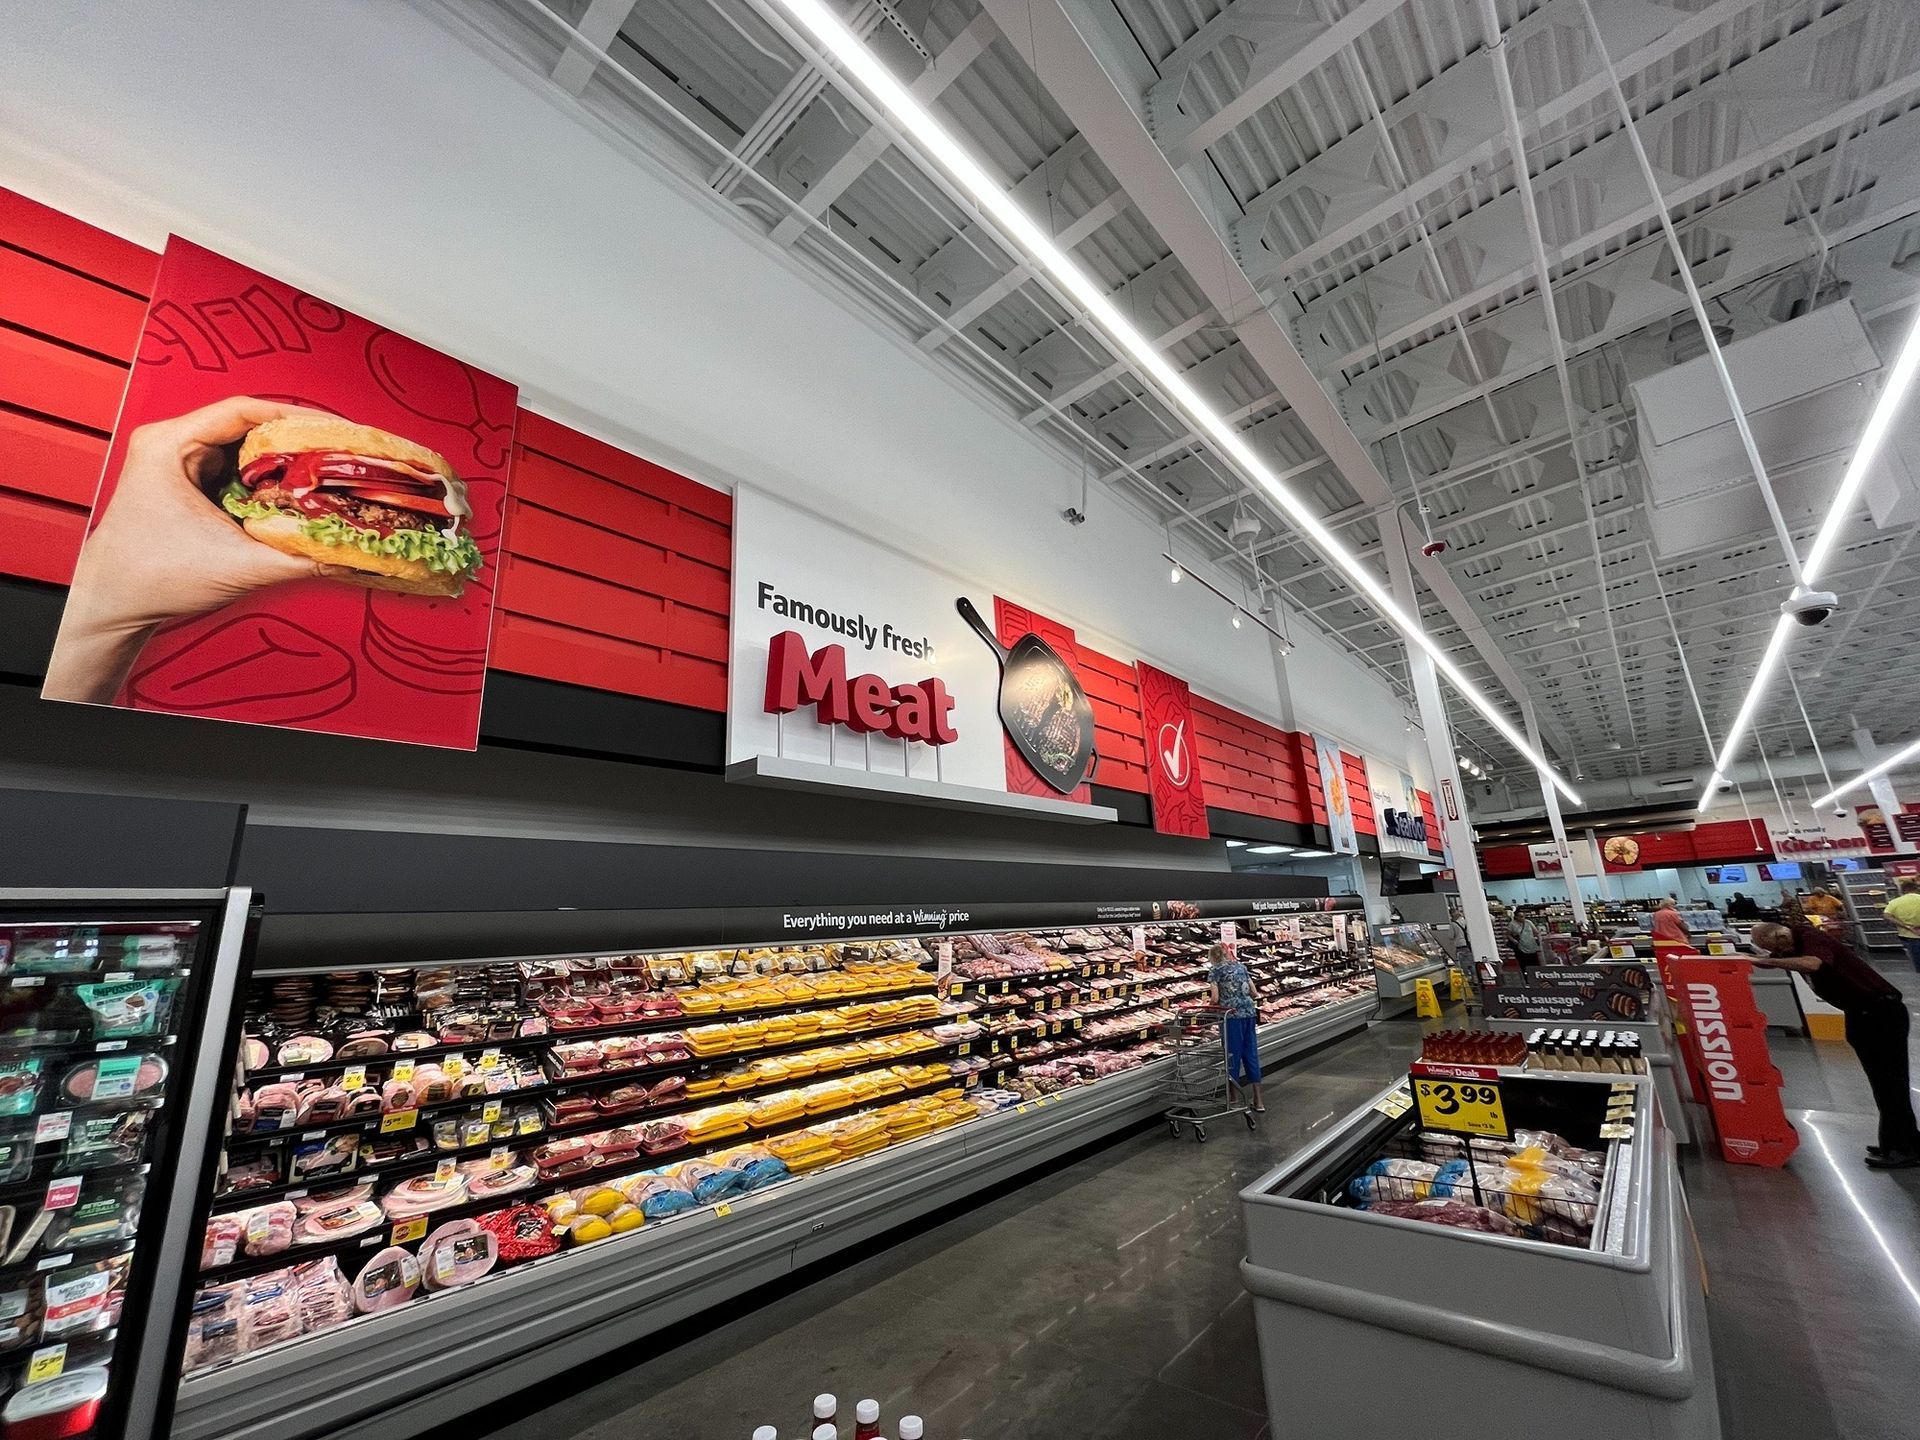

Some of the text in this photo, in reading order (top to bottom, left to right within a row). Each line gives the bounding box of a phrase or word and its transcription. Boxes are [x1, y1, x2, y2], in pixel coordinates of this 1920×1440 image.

[758, 581, 936, 665] Famously fresh
[763, 630, 959, 747] Meat
[1776, 836, 1868, 853] Kitchen
[1537, 859, 1562, 871] Del
[783, 909, 970, 931] Everything you need at a Winning price
[1535, 971, 1604, 980] Fresh sausage,
[1498, 994, 1584, 1007] Fresh sausage,
[1526, 1006, 1549, 1014] made
[1550, 1006, 1560, 1016] by
[1426, 1065, 1480, 1078] Winning Deals
[1490, 1111, 1499, 1120] lb
[51, 1193, 75, 1202] New
